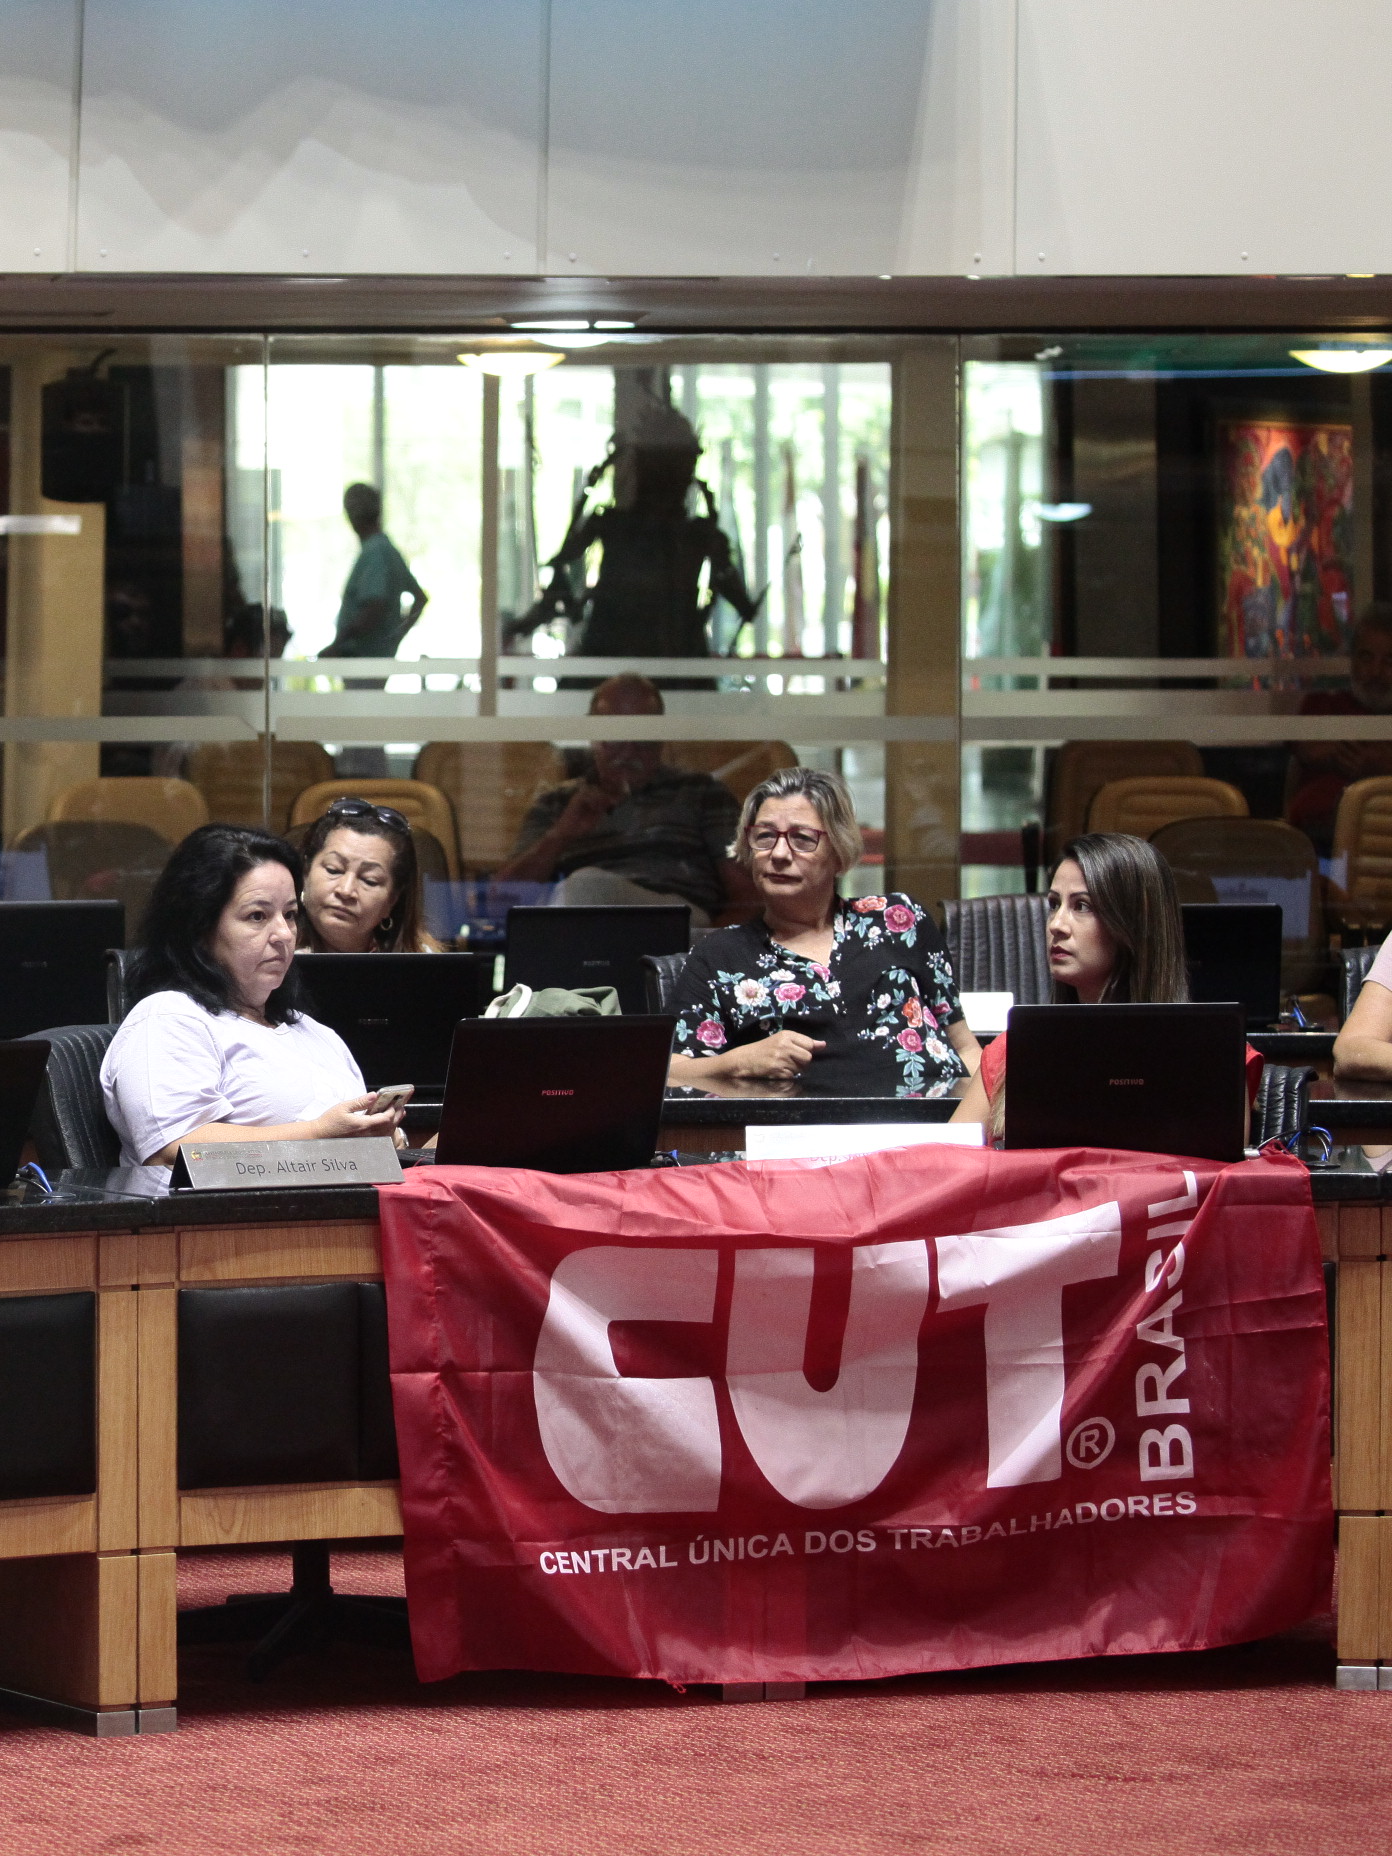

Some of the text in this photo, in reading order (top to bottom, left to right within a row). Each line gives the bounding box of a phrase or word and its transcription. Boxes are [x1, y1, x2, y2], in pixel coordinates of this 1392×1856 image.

[541, 1088, 574, 1096] POSITIVO
[235, 1158, 358, 1177] Dep. Altair Silva
[533, 1199, 1121, 1514] CUT
[1135, 1170, 1198, 1482] BRASIL
[539, 1491, 1198, 1575] CENTRAL ÚNICA DOS TRABALHADORES
